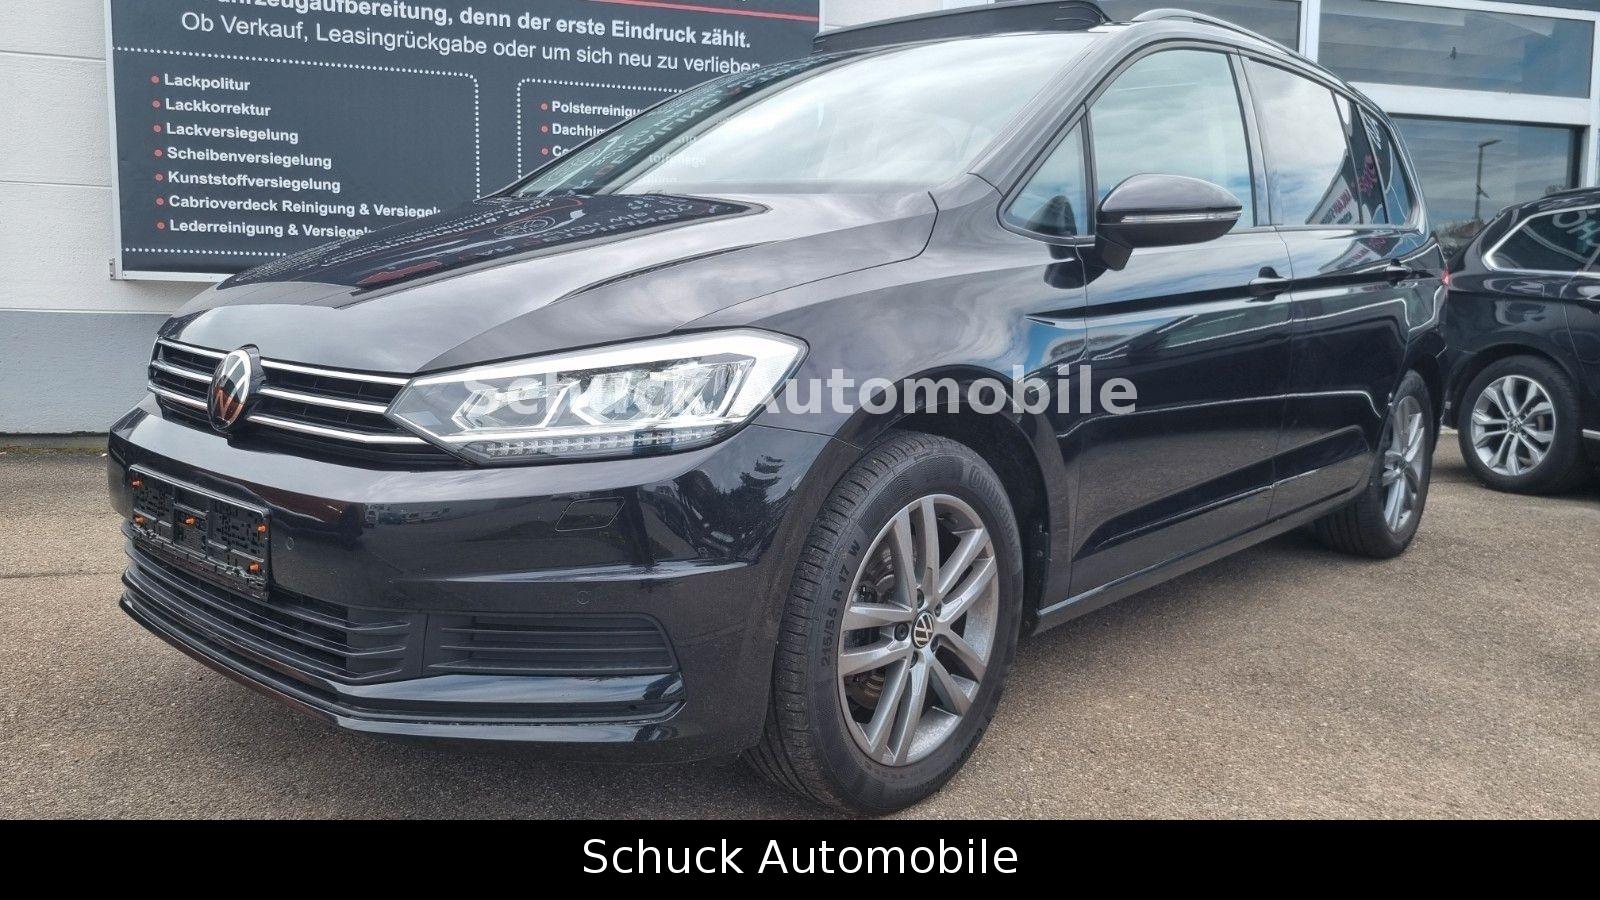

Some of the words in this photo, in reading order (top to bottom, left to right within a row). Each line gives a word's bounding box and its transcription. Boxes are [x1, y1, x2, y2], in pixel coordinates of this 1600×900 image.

[459, 7, 511, 28] denn
[517, 13, 551, 32] der
[556, 18, 606, 36] erste
[611, 20, 696, 44] Eindruck
[701, 28, 751, 48] zählt.
[181, 12, 214, 32] Ob
[221, 15, 309, 43] Verkauf,
[316, 23, 487, 56] Leasingrückgabe
[494, 39, 534, 59] oder
[542, 46, 571, 62] um
[576, 46, 613, 65] sich
[618, 52, 652, 69] neu
[657, 55, 678, 70] zu
[164, 74, 250, 92] Lackpolitur
[165, 98, 271, 117] Lackkorrektur
[166, 123, 299, 145] Lackversiegelung
[167, 147, 332, 170] Scheibenversiegelung
[168, 171, 341, 194] Kunststoffversiegelung
[169, 195, 278, 212] Cabrioverdeck
[282, 200, 355, 218] Reinigung
[359, 203, 370, 216] &
[373, 203, 440, 219] Versiegel
[170, 219, 284, 238] Lederreinigung
[288, 224, 299, 237] &
